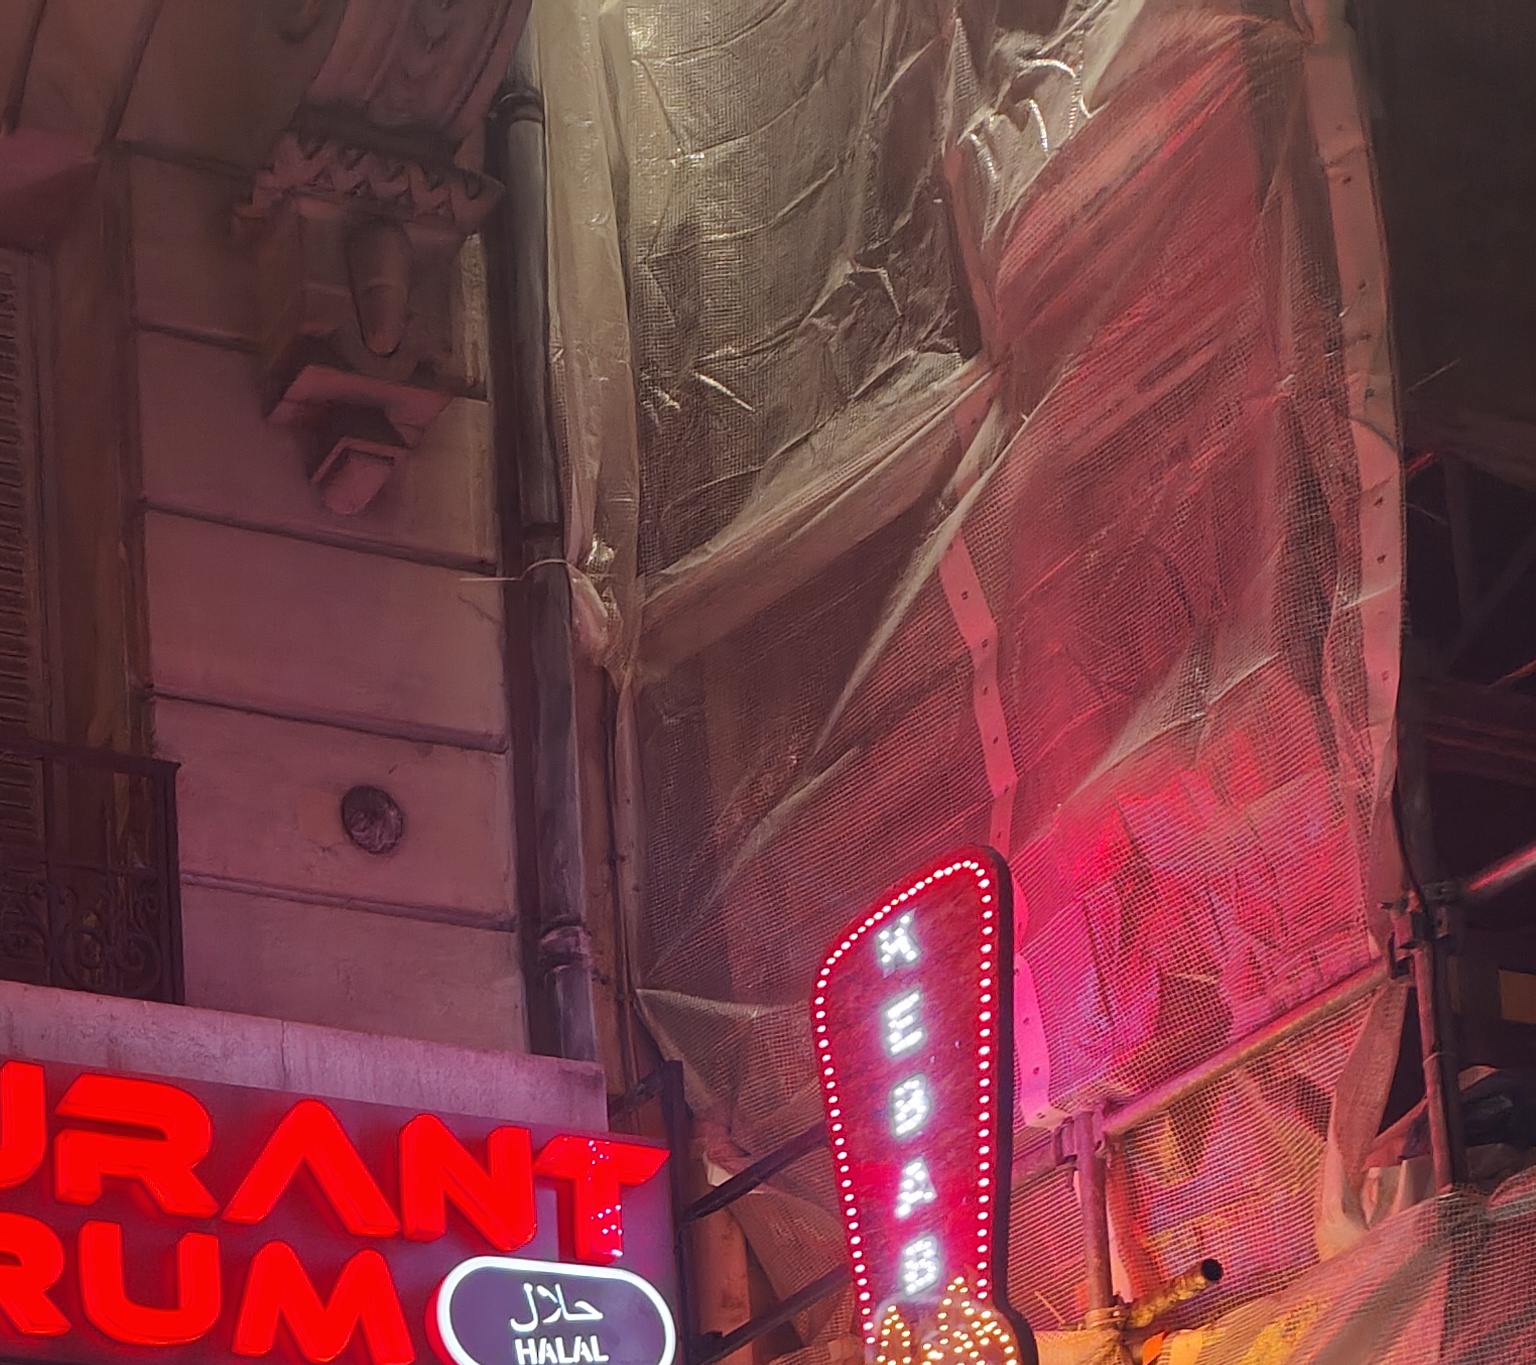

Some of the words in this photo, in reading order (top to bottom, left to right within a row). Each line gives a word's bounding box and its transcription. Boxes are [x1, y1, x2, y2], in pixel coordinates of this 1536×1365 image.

[874, 908, 944, 1298] KEBAB
[510, 1282, 604, 1332] حلال
[514, 1335, 610, 1365] HALAL
